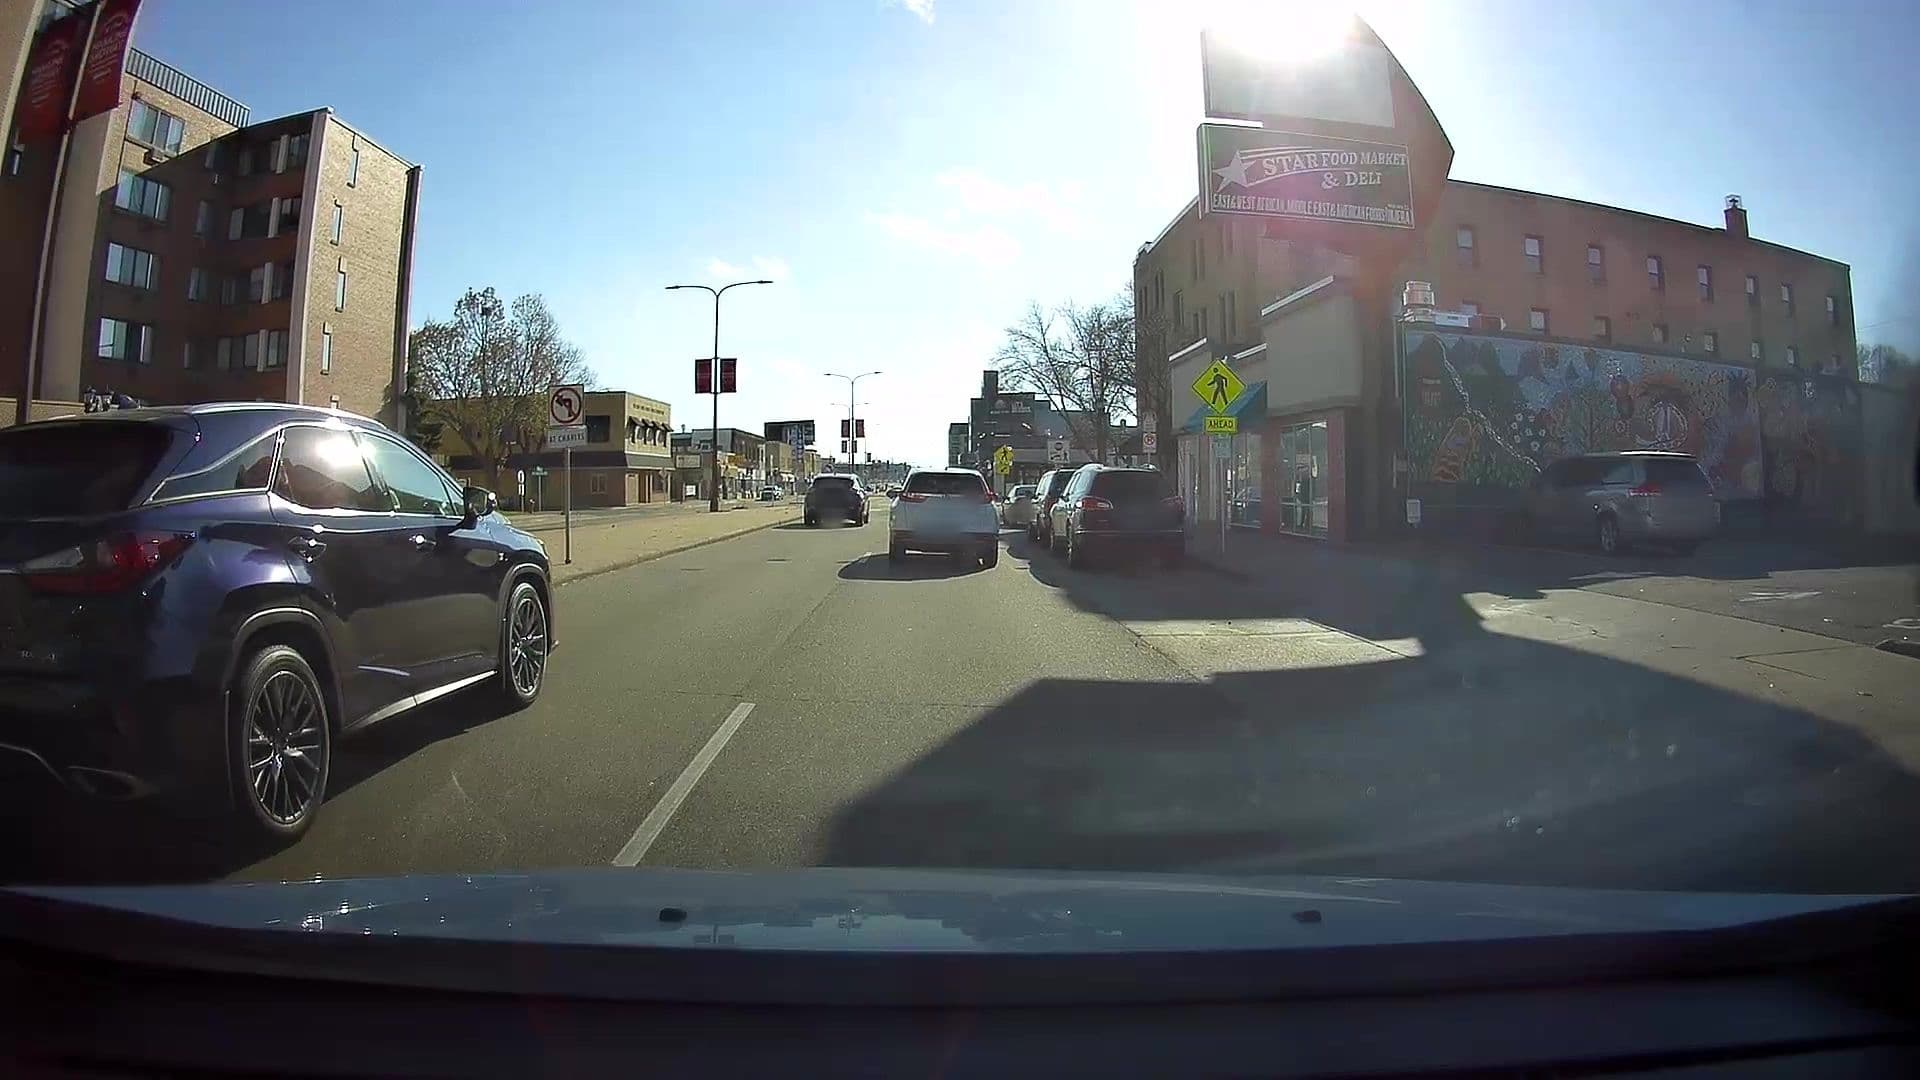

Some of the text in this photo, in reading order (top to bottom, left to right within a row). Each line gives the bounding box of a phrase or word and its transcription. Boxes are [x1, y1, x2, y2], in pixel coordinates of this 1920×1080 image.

[1262, 152, 1407, 177] STAR FOOD MARKET
[1320, 171, 1383, 190] & DELI
[1208, 420, 1233, 429] AHEAD
